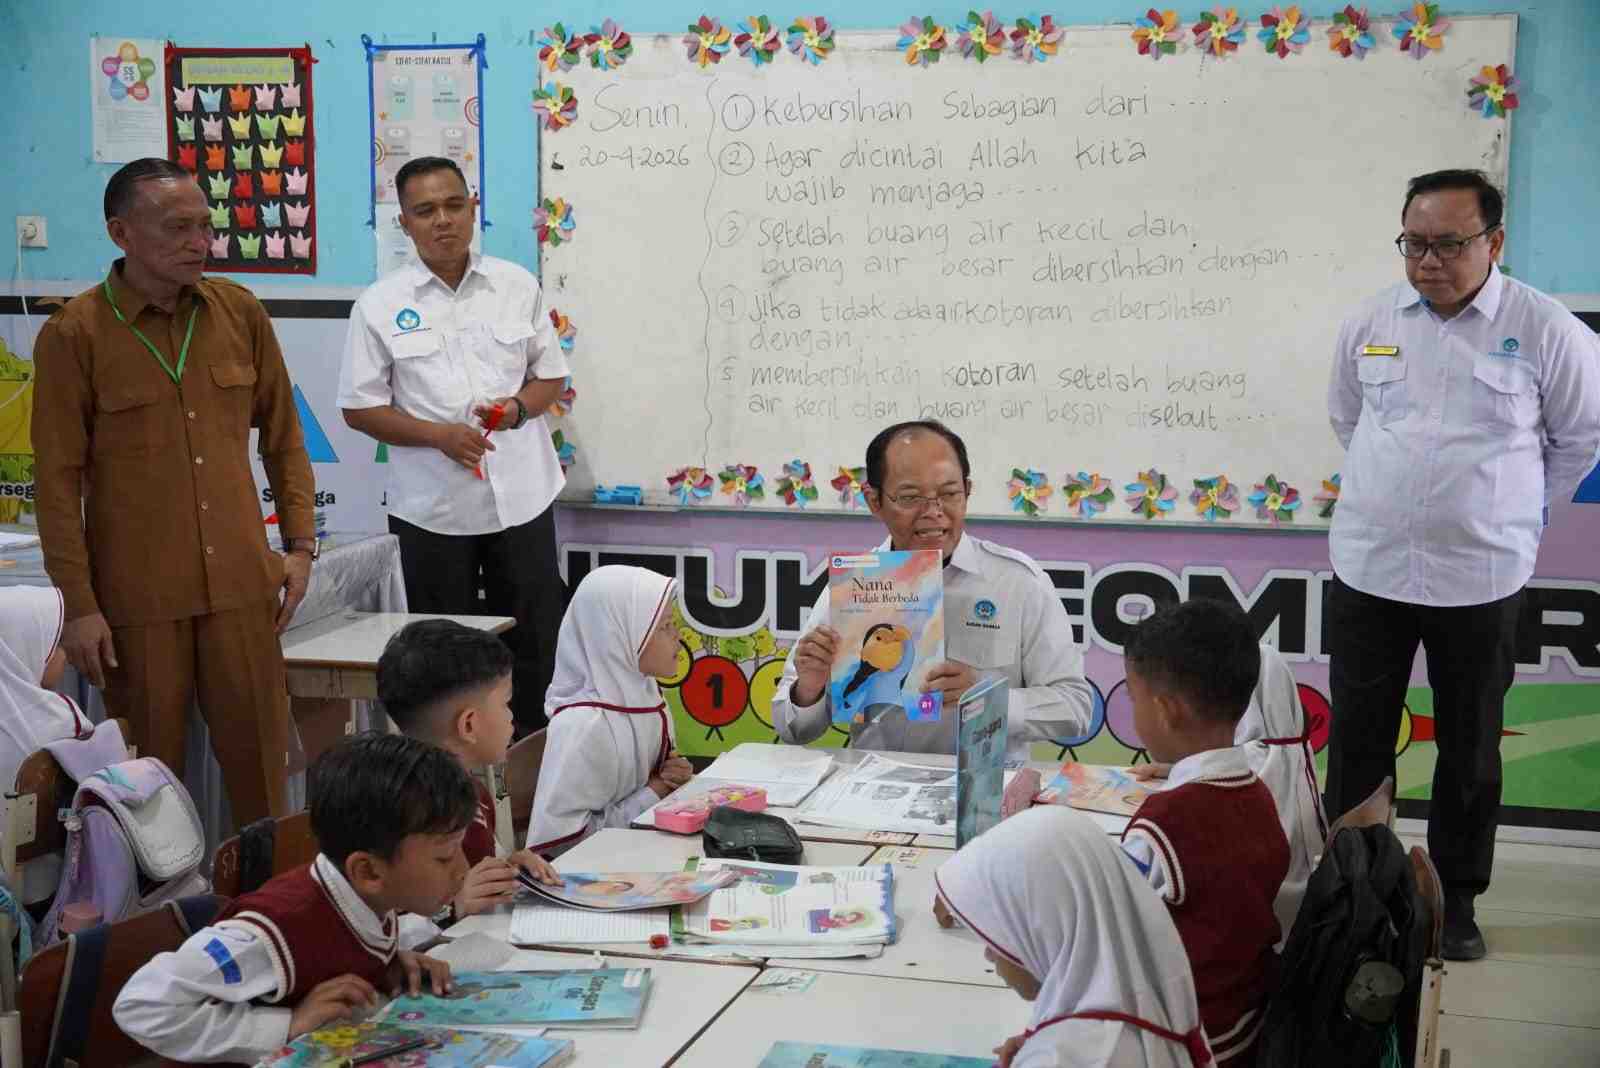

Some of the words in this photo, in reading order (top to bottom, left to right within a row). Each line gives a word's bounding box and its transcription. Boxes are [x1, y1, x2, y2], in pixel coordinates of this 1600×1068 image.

[764, 89, 913, 125] Kebersihan
[943, 90, 1056, 126] Sebagian
[1085, 86, 1148, 116] dari
[766, 141, 823, 177] Agar
[839, 138, 943, 170] dicintai
[969, 139, 1038, 172] Allah
[867, 214, 949, 255] buang
[968, 218, 1016, 246] air
[761, 256, 844, 286] buang
[863, 255, 909, 273] air
[1198, 246, 1289, 279] dengan
[819, 294, 887, 322] tidak
[1057, 363, 1150, 393] setelah
[1166, 361, 1247, 399] buang
[748, 393, 783, 415] air
[1126, 400, 1219, 432] disebut
[852, 577, 894, 592] Nana
[705, 673, 723, 709] 1
